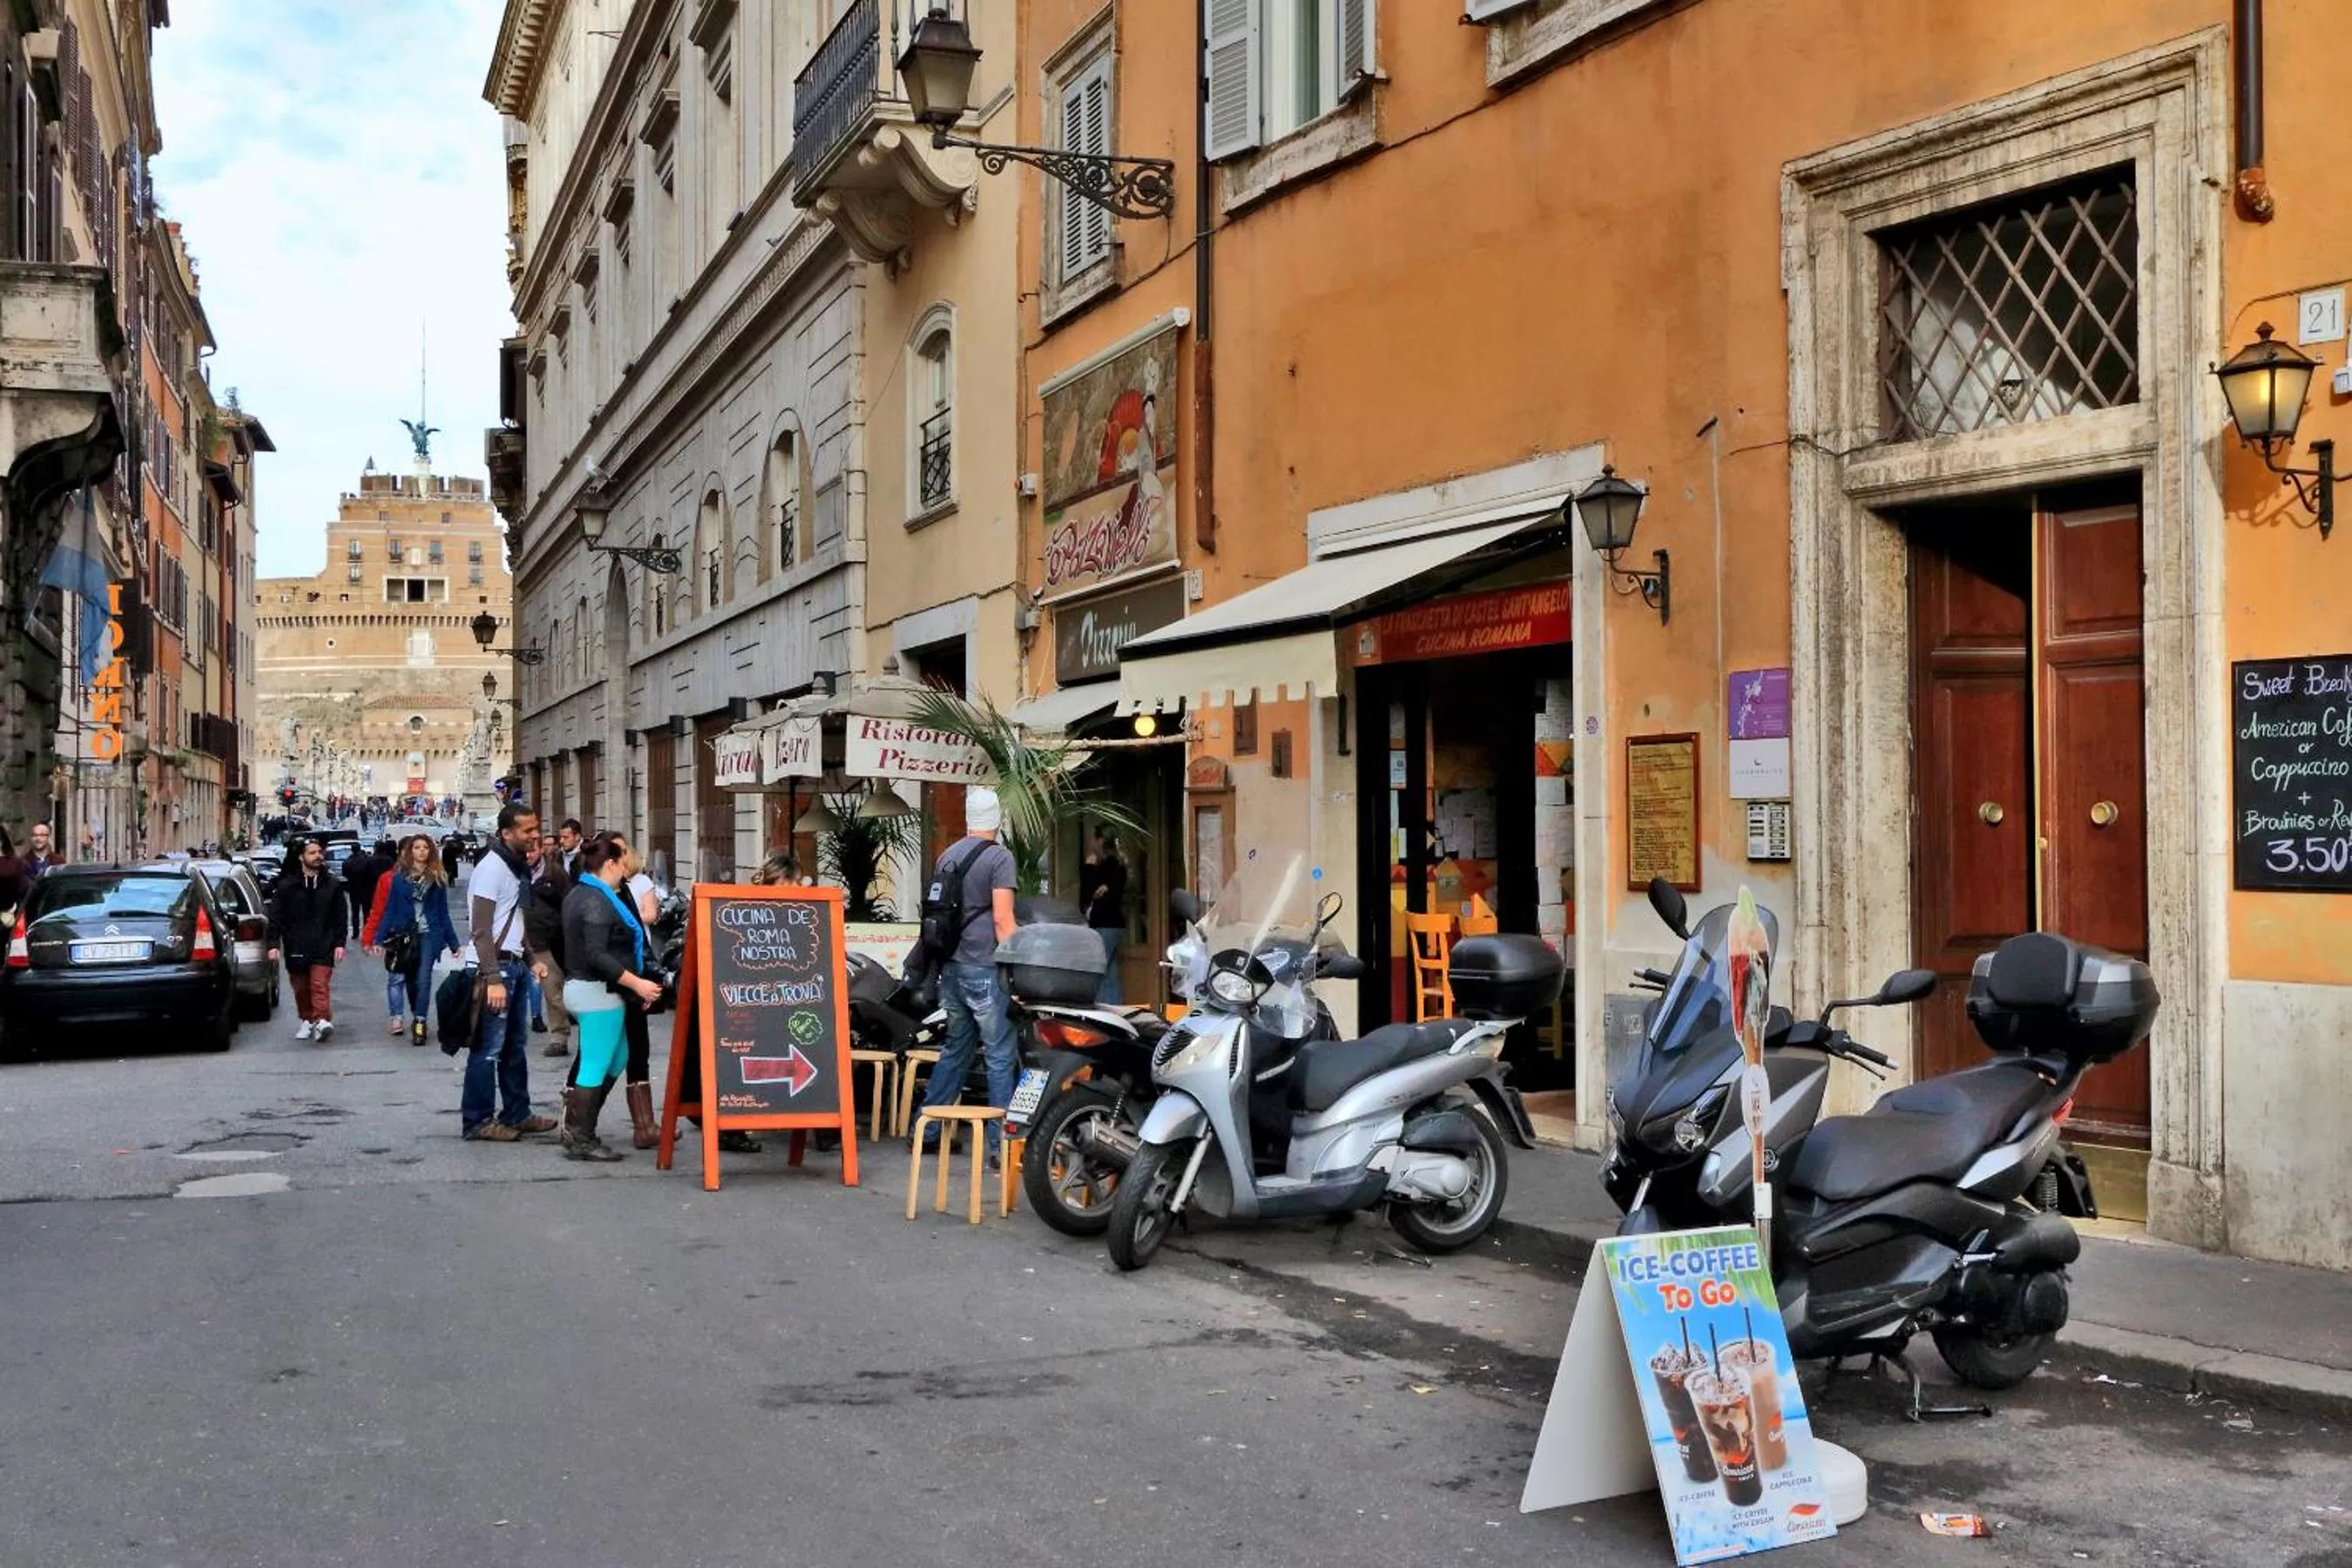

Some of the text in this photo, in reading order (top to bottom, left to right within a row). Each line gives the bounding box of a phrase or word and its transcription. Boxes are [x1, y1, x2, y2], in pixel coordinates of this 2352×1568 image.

[2308, 299, 2336, 333] 21
[1416, 621, 1532, 652] CUCINA ROMANA
[2243, 665, 2295, 700] Sweet
[2240, 711, 2318, 740] American
[878, 747, 990, 777] Pizzeria
[2298, 742, 2315, 754] or
[2251, 757, 2349, 793] Cappuccino
[721, 909, 811, 925] CUCINA DE
[747, 928, 791, 945] ROMA
[740, 946, 798, 961] NOSTRA
[1619, 1244, 1759, 1283] ICE-COFFEE
